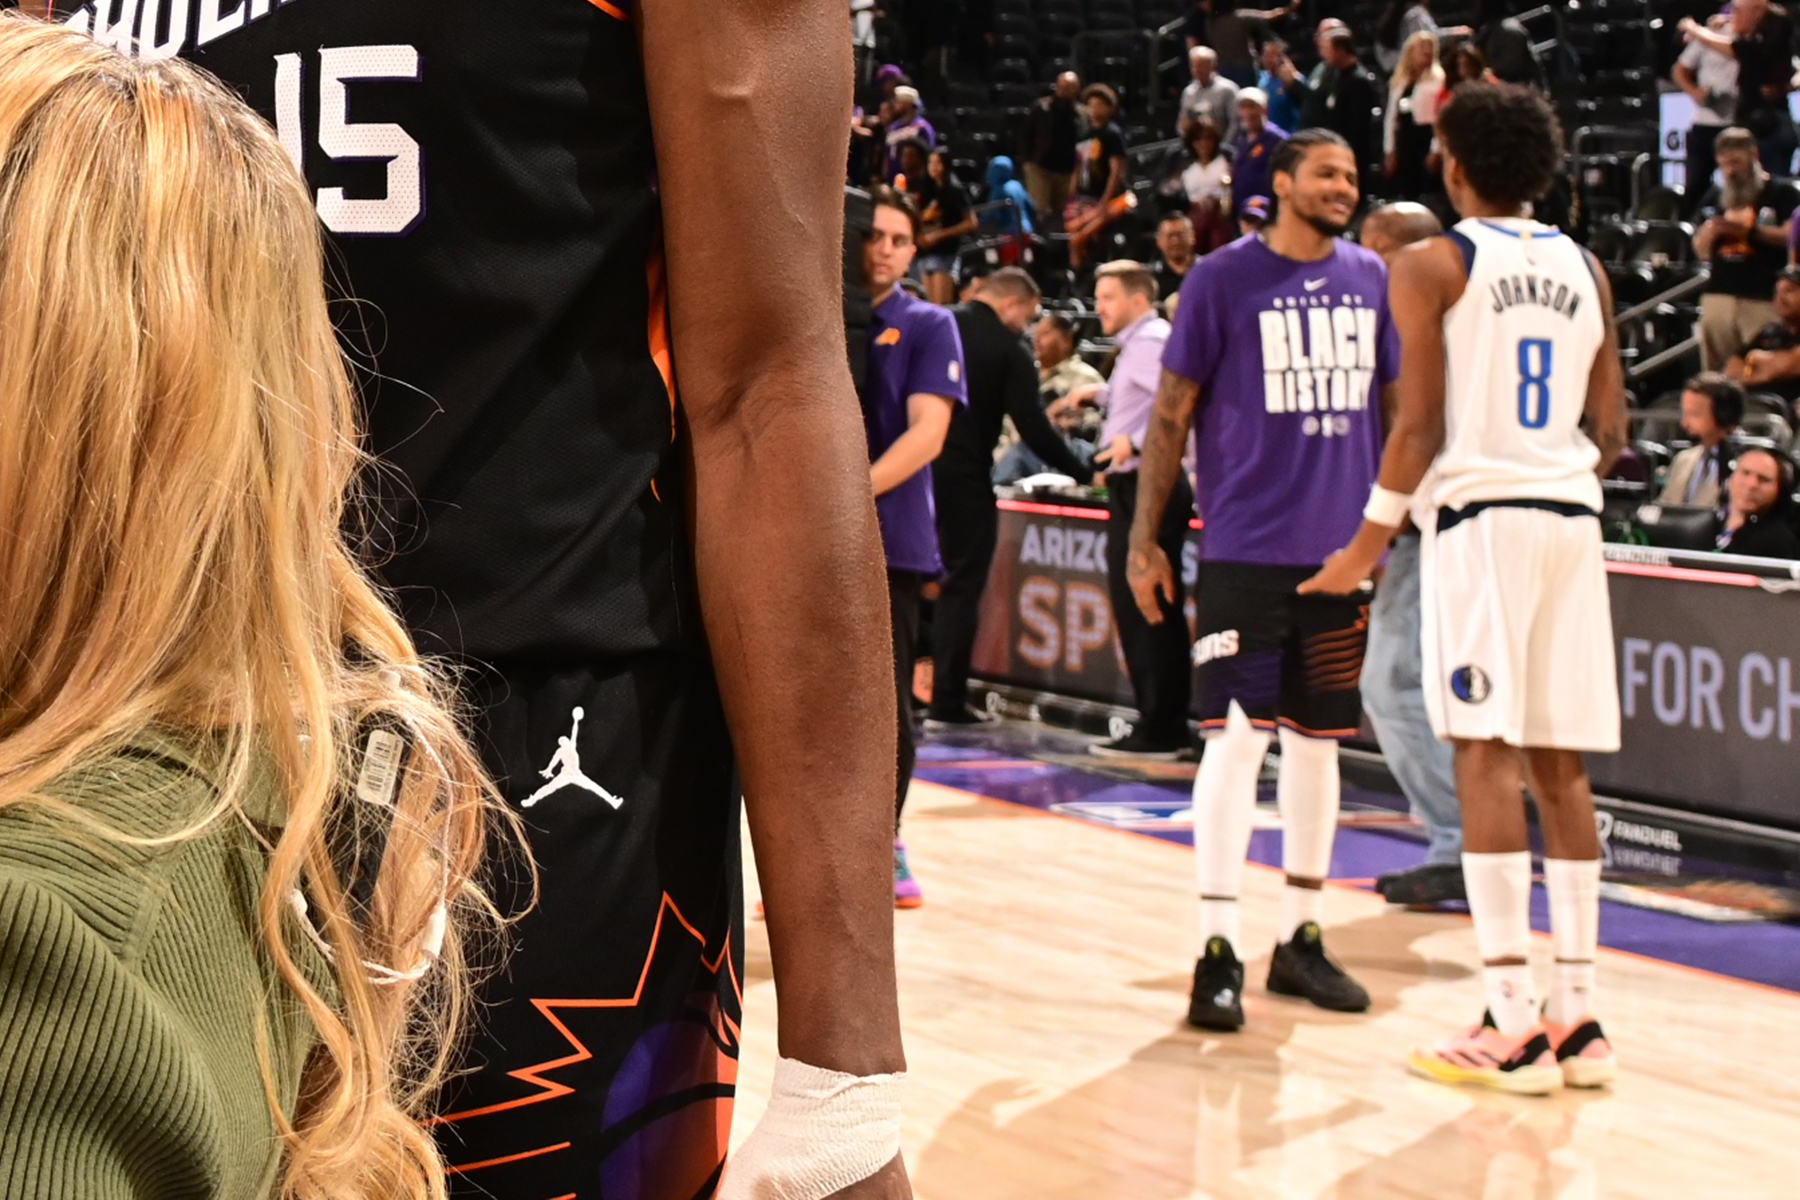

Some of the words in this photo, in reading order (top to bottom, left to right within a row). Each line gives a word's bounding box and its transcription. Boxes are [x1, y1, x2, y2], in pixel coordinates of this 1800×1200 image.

[273, 43, 427, 238] 15
[1489, 274, 1581, 320] JOHNSON
[1258, 305, 1377, 372] BLACK
[1263, 368, 1375, 414] HISTORY
[1517, 337, 1553, 430] 8
[1623, 636, 1726, 734] FOR
